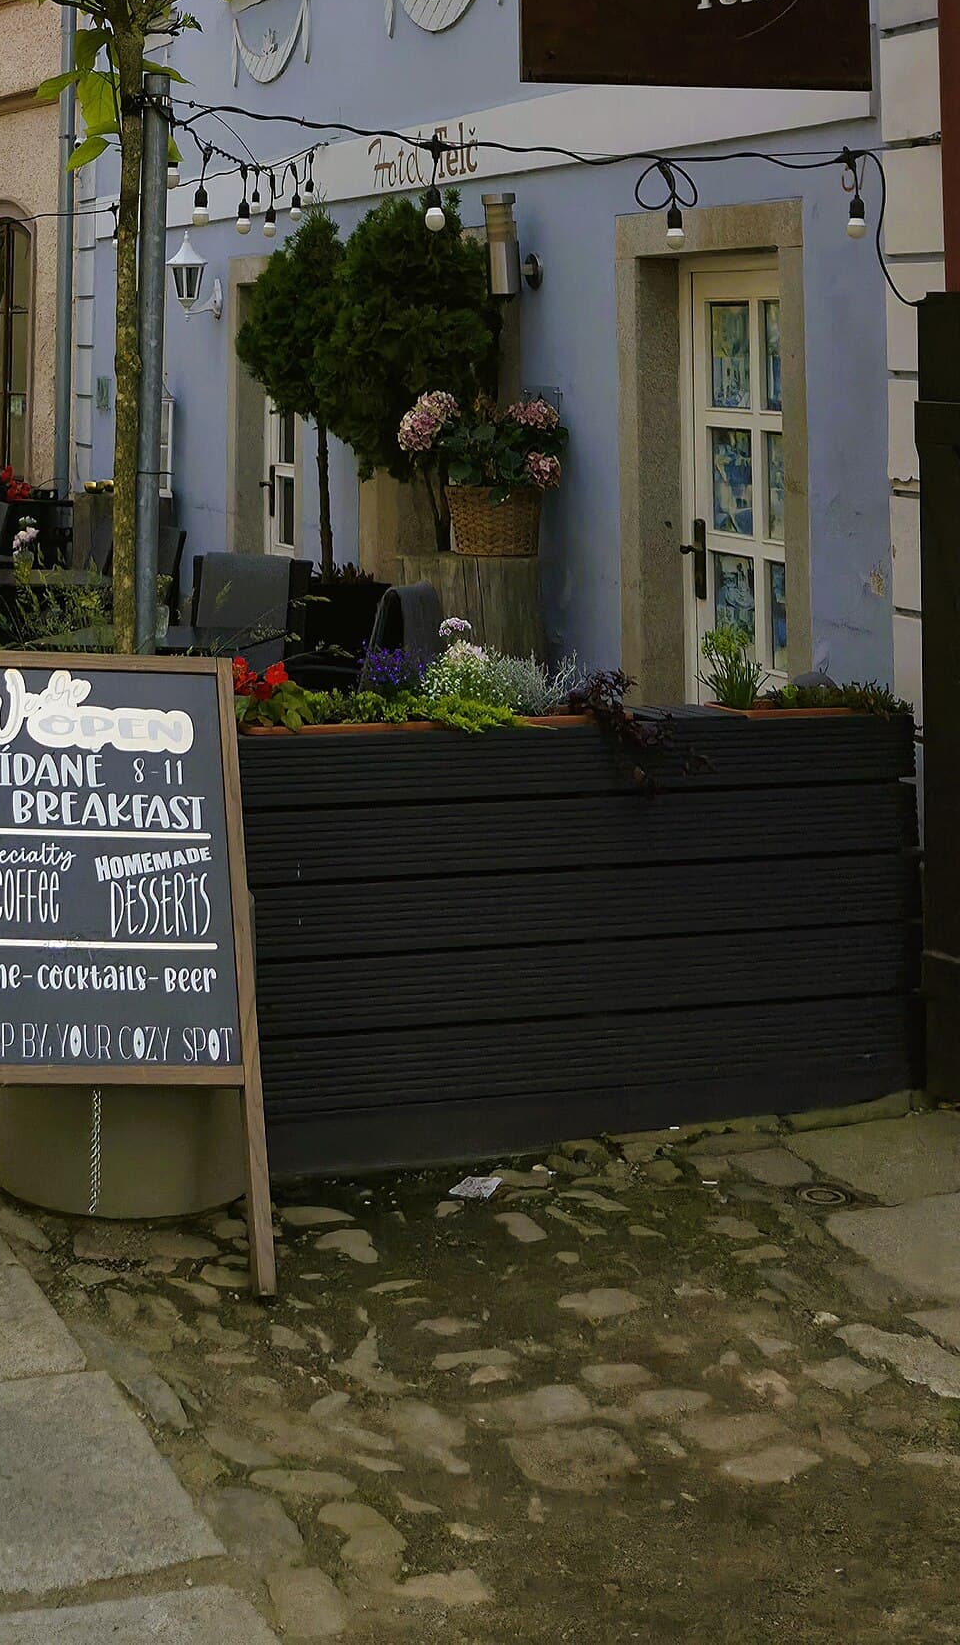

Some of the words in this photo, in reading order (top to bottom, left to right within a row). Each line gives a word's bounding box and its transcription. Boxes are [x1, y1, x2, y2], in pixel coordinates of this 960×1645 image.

[367, 130, 428, 189] Hotel
[32, 710, 189, 748] OPEN
[12, 790, 206, 830] BREAKFAST
[94, 846, 212, 882] HOMEMADE
[110, 872, 211, 938] DESSERTS
[56, 1023, 111, 1060] YOUR
[118, 1025, 170, 1061] COZY
[182, 1027, 233, 1062] SPOT
